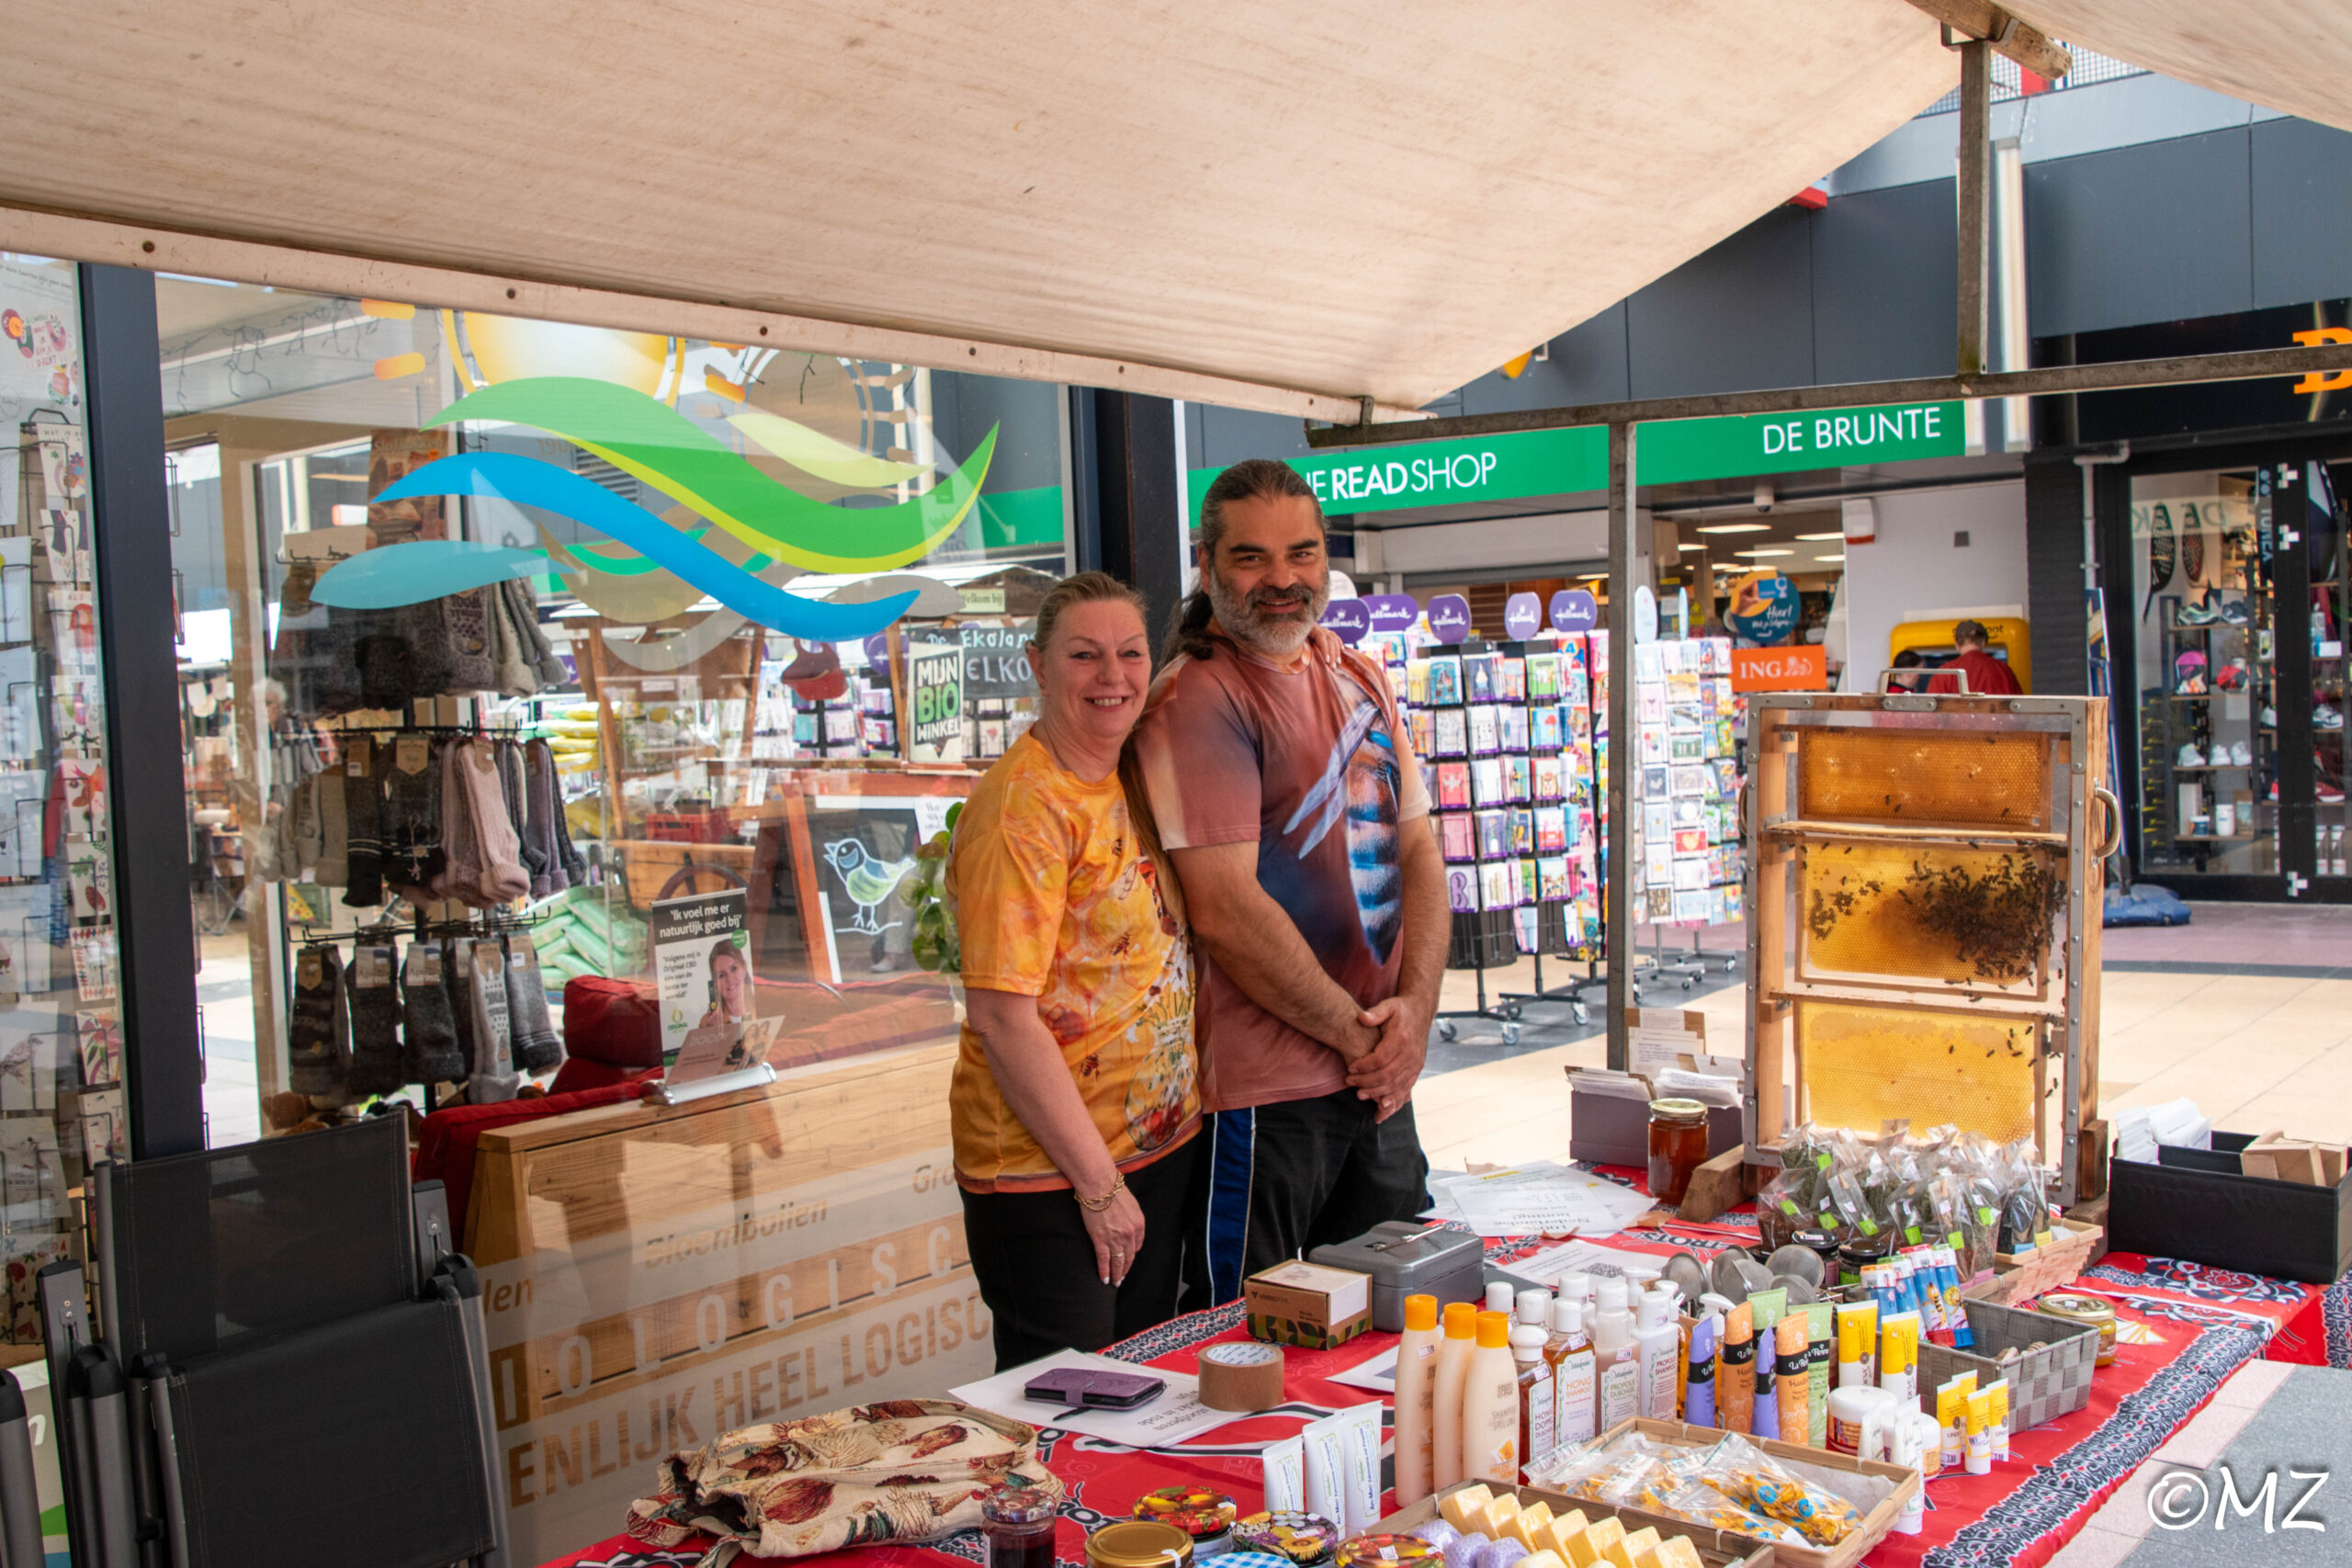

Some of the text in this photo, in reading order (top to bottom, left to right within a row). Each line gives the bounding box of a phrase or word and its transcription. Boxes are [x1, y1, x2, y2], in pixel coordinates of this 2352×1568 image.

[1762, 406, 1941, 455] DE BRUNTE
[964, 592, 990, 604] elkom
[1370, 607, 1412, 621] allmark
[917, 655, 959, 688] MIJN
[966, 655, 1032, 683] ELKO
[1739, 660, 1782, 680] ING
[917, 682, 960, 724] BIO
[916, 720, 961, 742] WINKEL
[683, 906, 704, 919] voel
[704, 906, 719, 917] me
[719, 903, 731, 913] er
[659, 920, 705, 939] natuurlijk
[704, 916, 728, 934] goed
[662, 963, 685, 974] Original
[483, 1278, 535, 1316] len
[500, 1225, 953, 1423] IOLOGISC
[1566, 1375, 1592, 1391] HONIG
[507, 1290, 991, 1509] ENLIJK HEEL LOGISC
